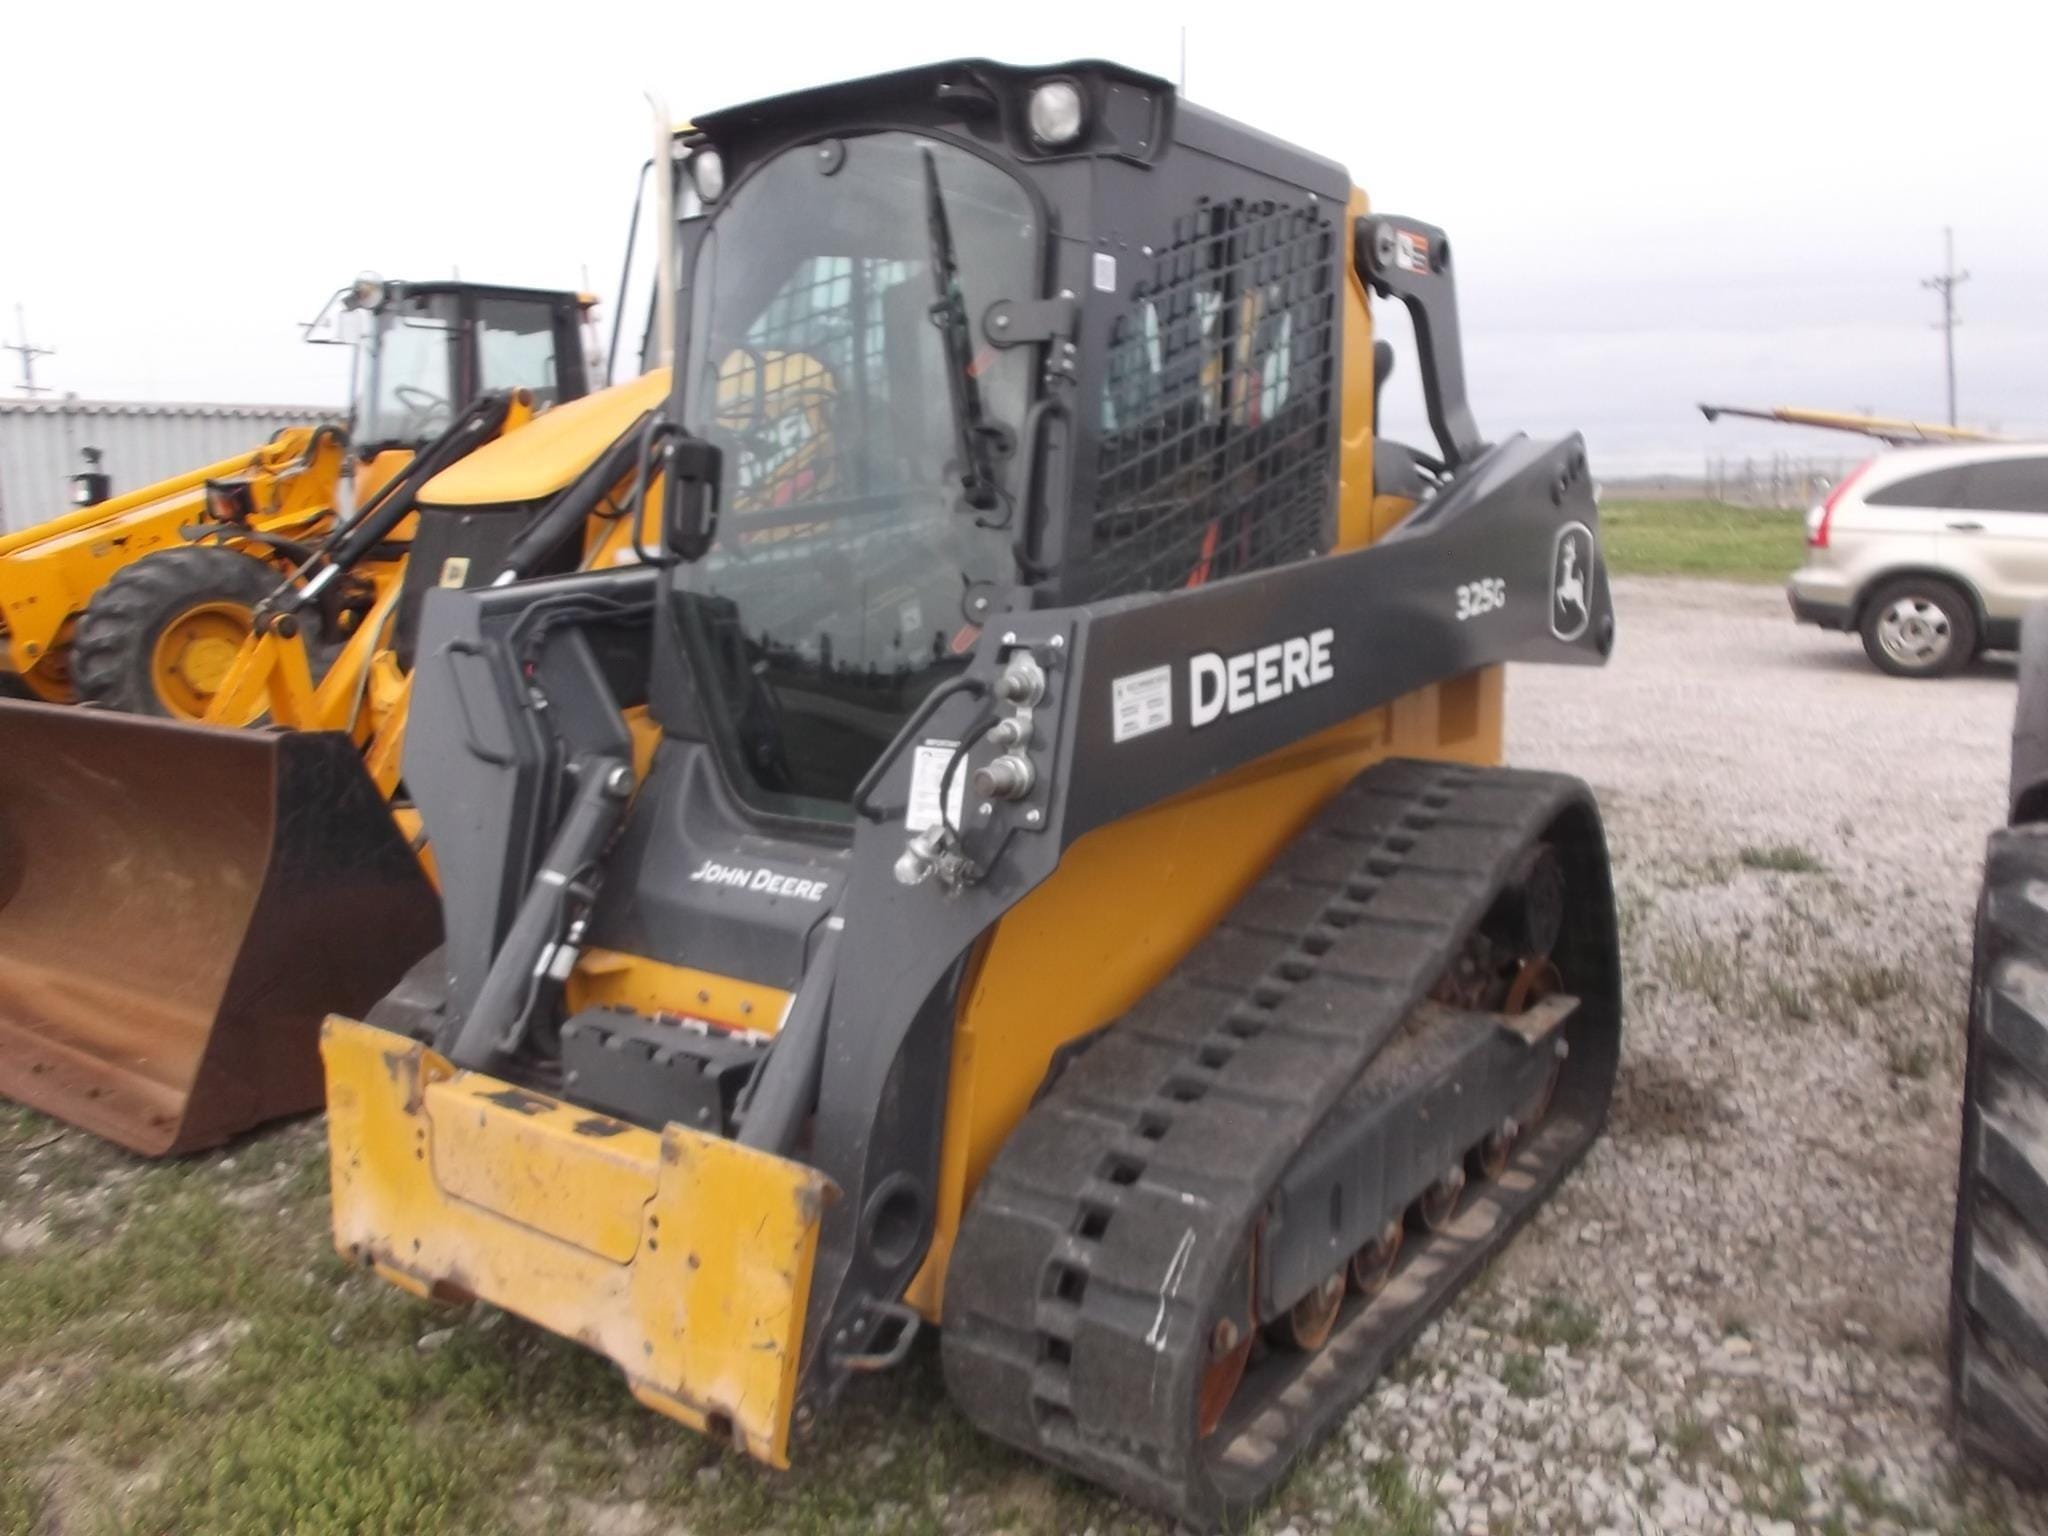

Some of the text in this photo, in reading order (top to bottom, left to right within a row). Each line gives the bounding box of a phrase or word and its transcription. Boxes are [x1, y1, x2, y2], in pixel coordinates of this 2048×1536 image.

[1456, 577, 1505, 621] 325G
[1190, 628, 1334, 727] DEERE
[689, 860, 828, 902] JOHN DEERE
